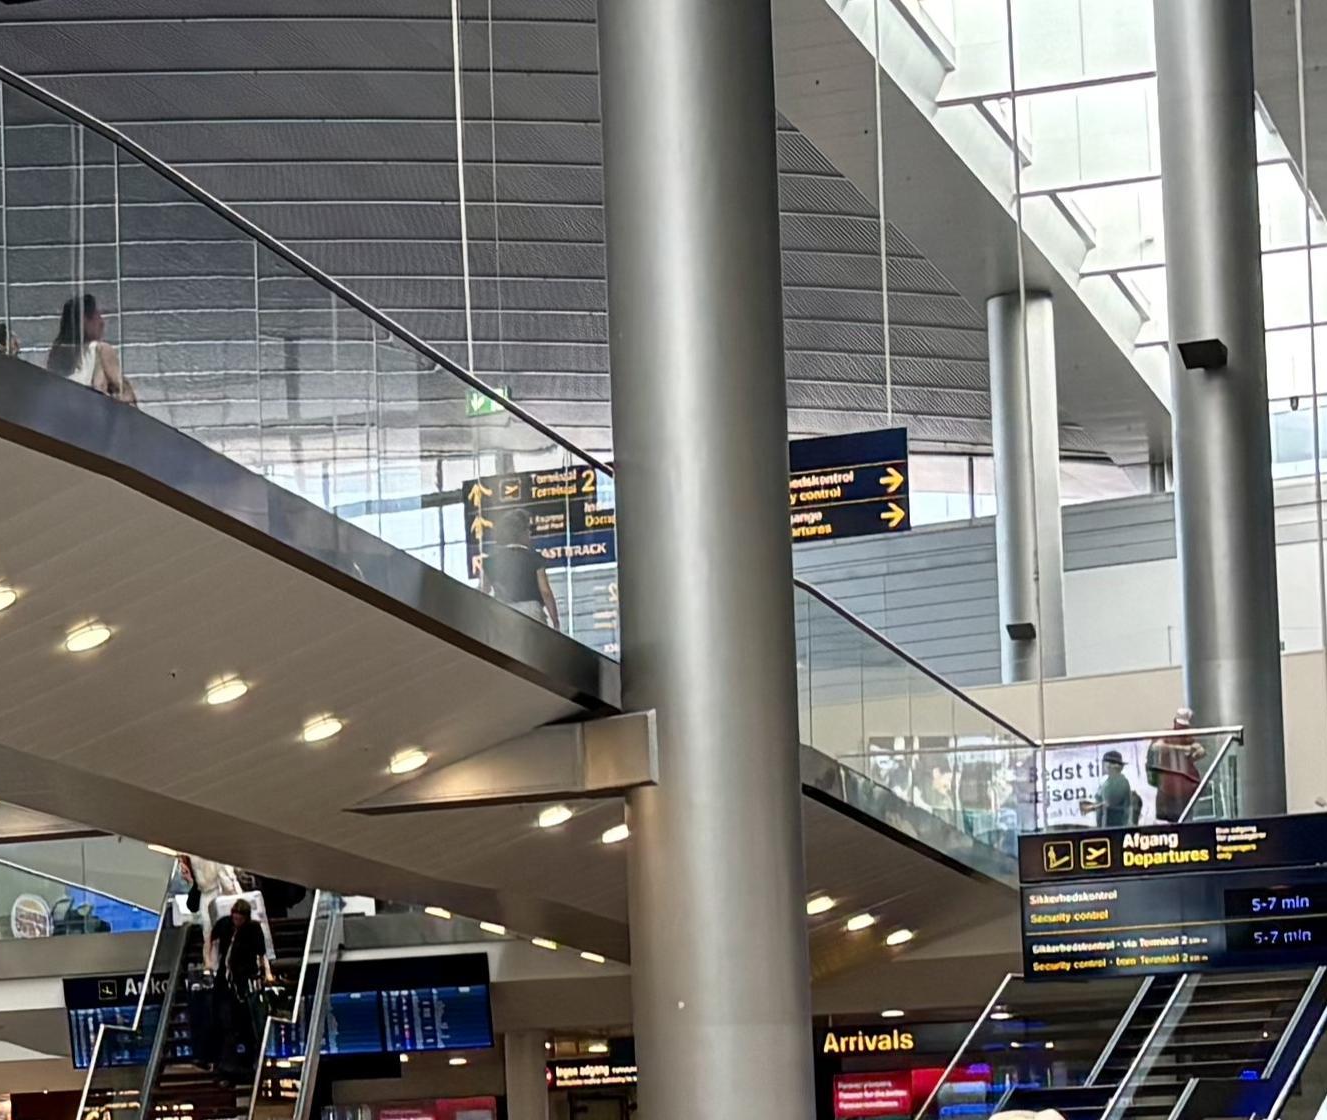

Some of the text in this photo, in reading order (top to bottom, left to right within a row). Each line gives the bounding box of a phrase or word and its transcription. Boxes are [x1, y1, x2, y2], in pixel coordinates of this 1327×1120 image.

[581, 469, 595, 493] 2
[799, 485, 841, 502] control
[1123, 832, 1178, 849] Afgang
[1123, 848, 1210, 868] Departures
[1029, 889, 1118, 905] Sikkerhedskontrol
[1252, 895, 1310, 912] 5-7 min
[1030, 909, 1109, 924] Security control
[1139, 935, 1179, 947] Terminal
[1181, 936, 1188, 944] 2
[1253, 928, 1312, 944] 5-7 min
[1033, 961, 1071, 972] Security
[1073, 958, 1106, 969] control
[1140, 953, 1180, 964] Terminal
[1182, 953, 1189, 963] 2
[823, 1028, 914, 1053] Arrivals
